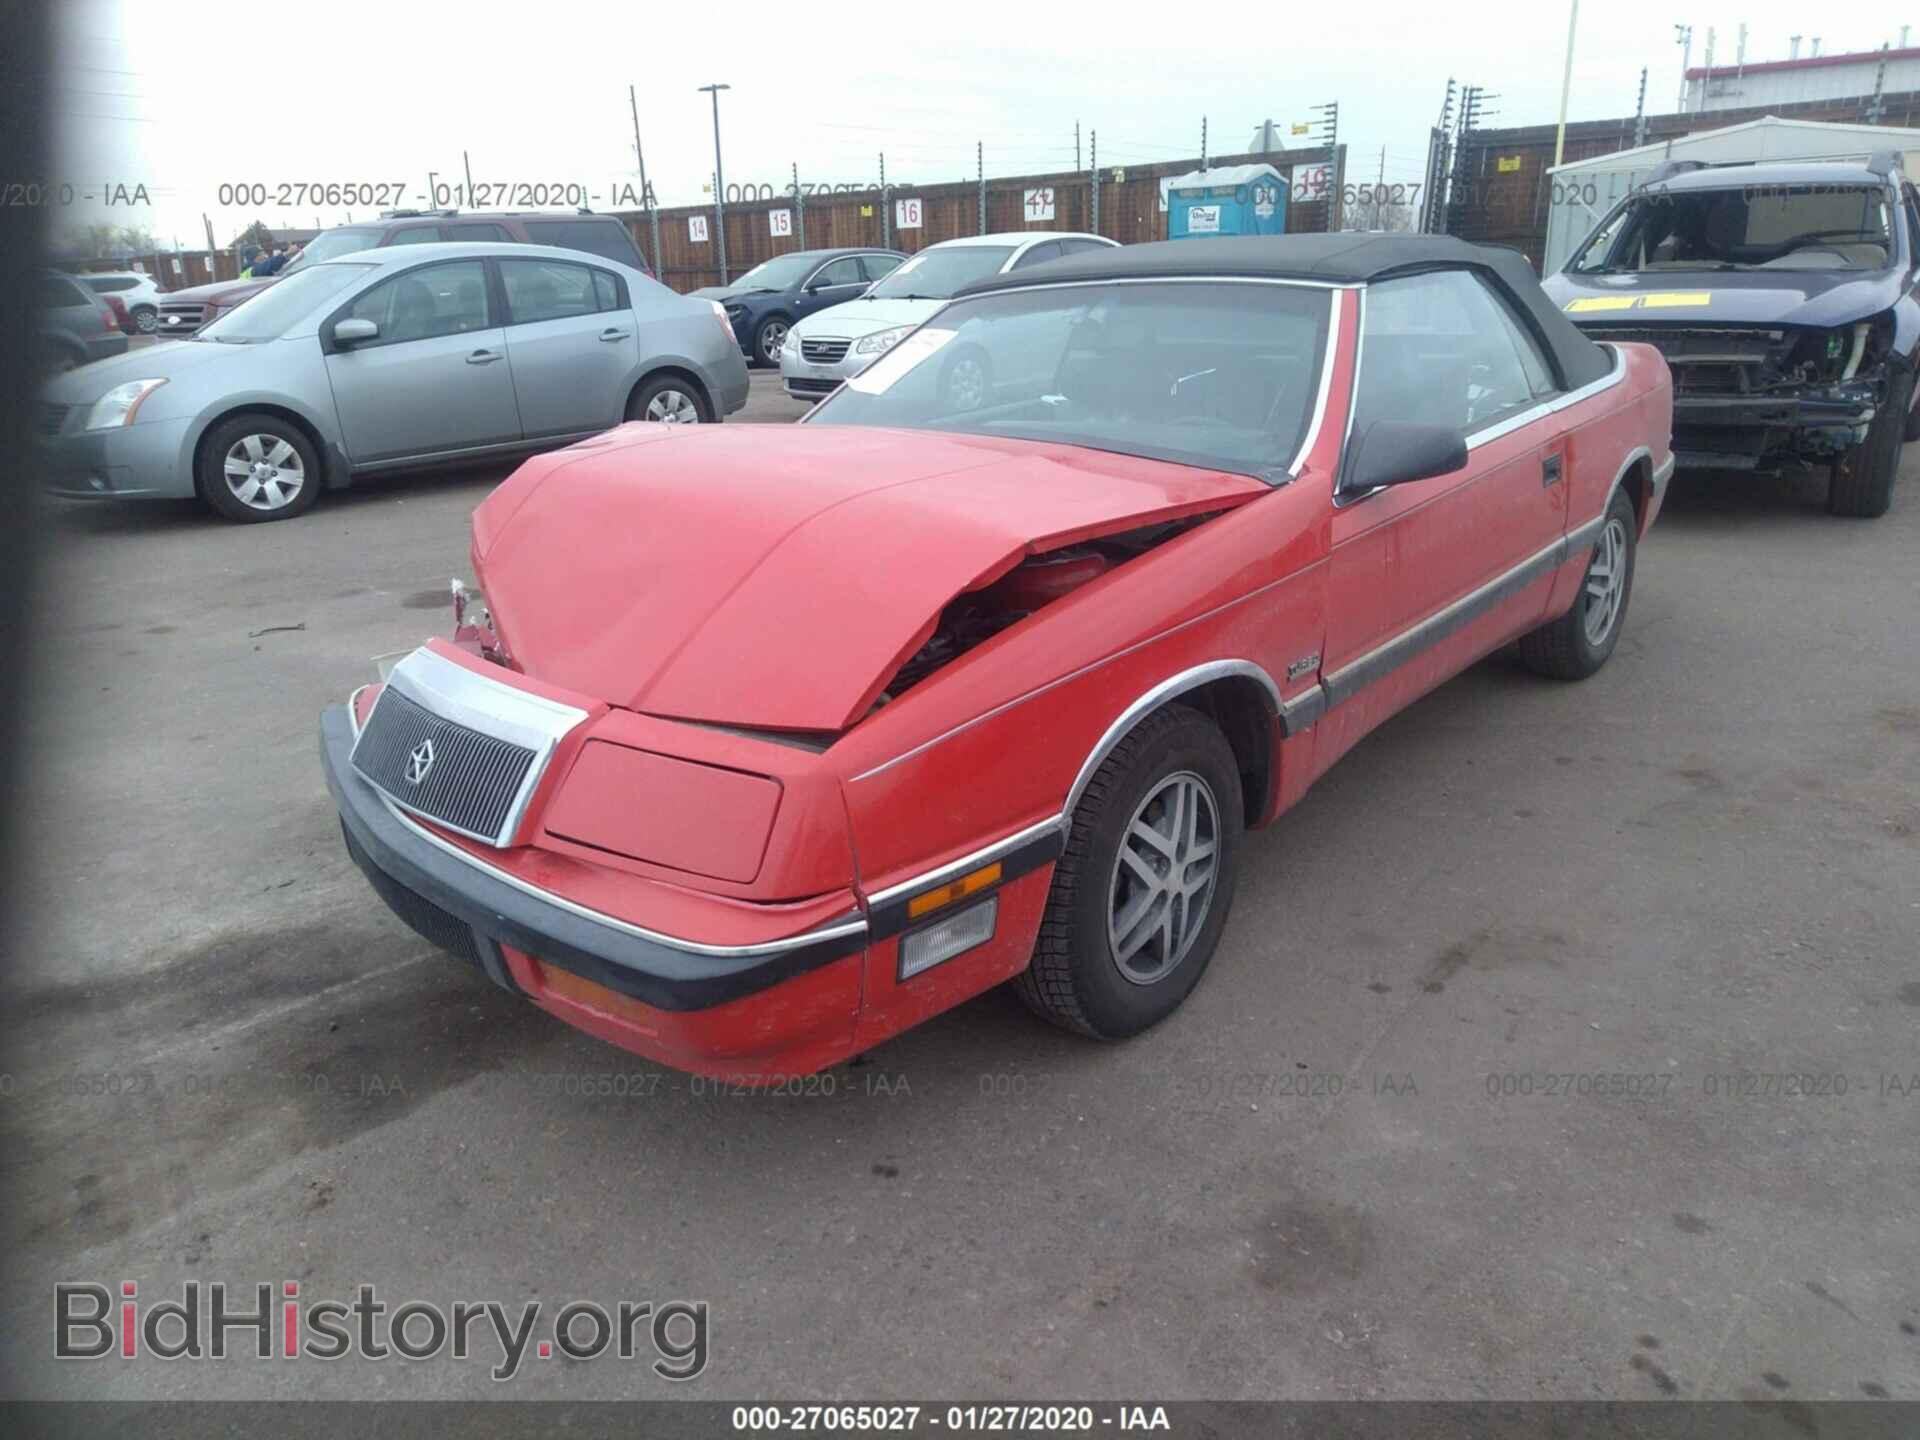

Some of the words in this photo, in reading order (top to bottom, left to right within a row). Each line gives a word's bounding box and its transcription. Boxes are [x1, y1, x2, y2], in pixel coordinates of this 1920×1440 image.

[773, 212, 788, 233] 15
[900, 200, 918, 224] 16
[691, 220, 706, 238] 14
